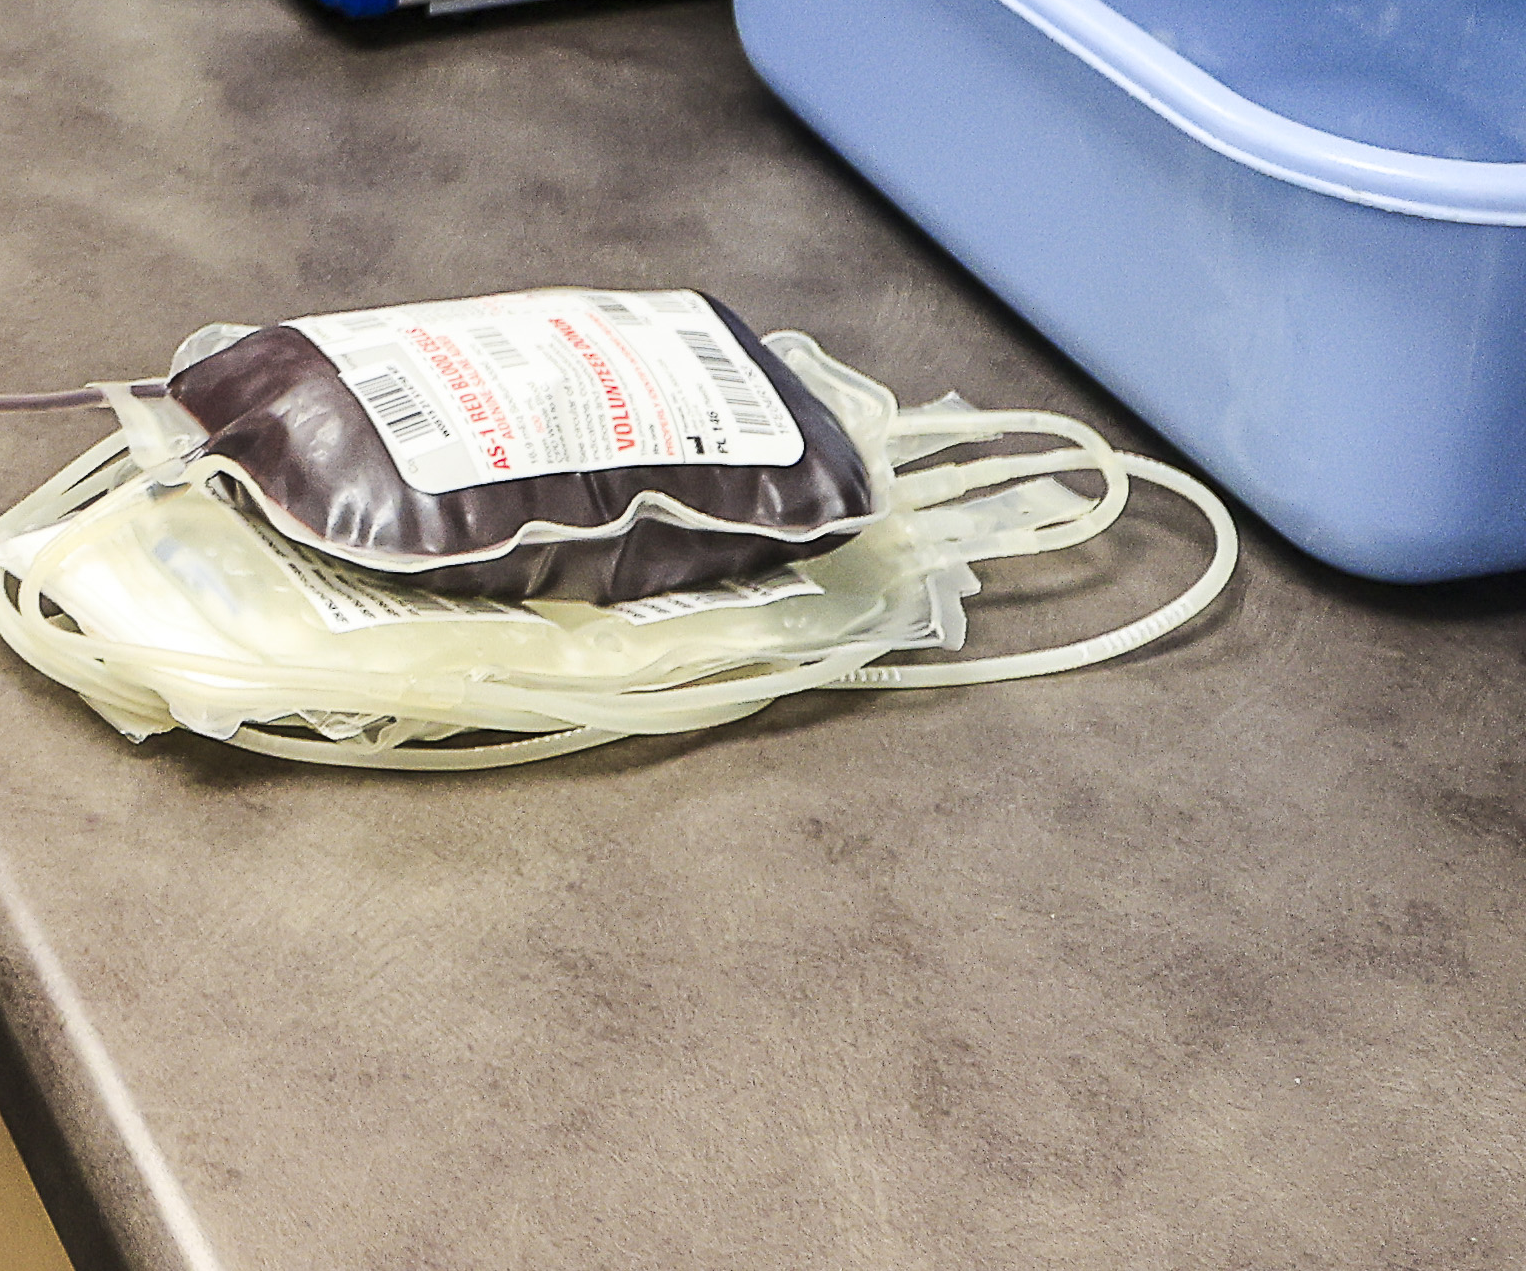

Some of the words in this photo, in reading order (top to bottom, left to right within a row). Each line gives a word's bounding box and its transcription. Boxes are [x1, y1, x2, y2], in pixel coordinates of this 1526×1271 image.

[405, 327, 441, 353] CELLS
[430, 354, 470, 390] BLOOD
[459, 393, 489, 423] RED
[582, 352, 636, 452] VOLUNTEER
[479, 428, 511, 470] AS-1
[716, 437, 730, 454] PL
